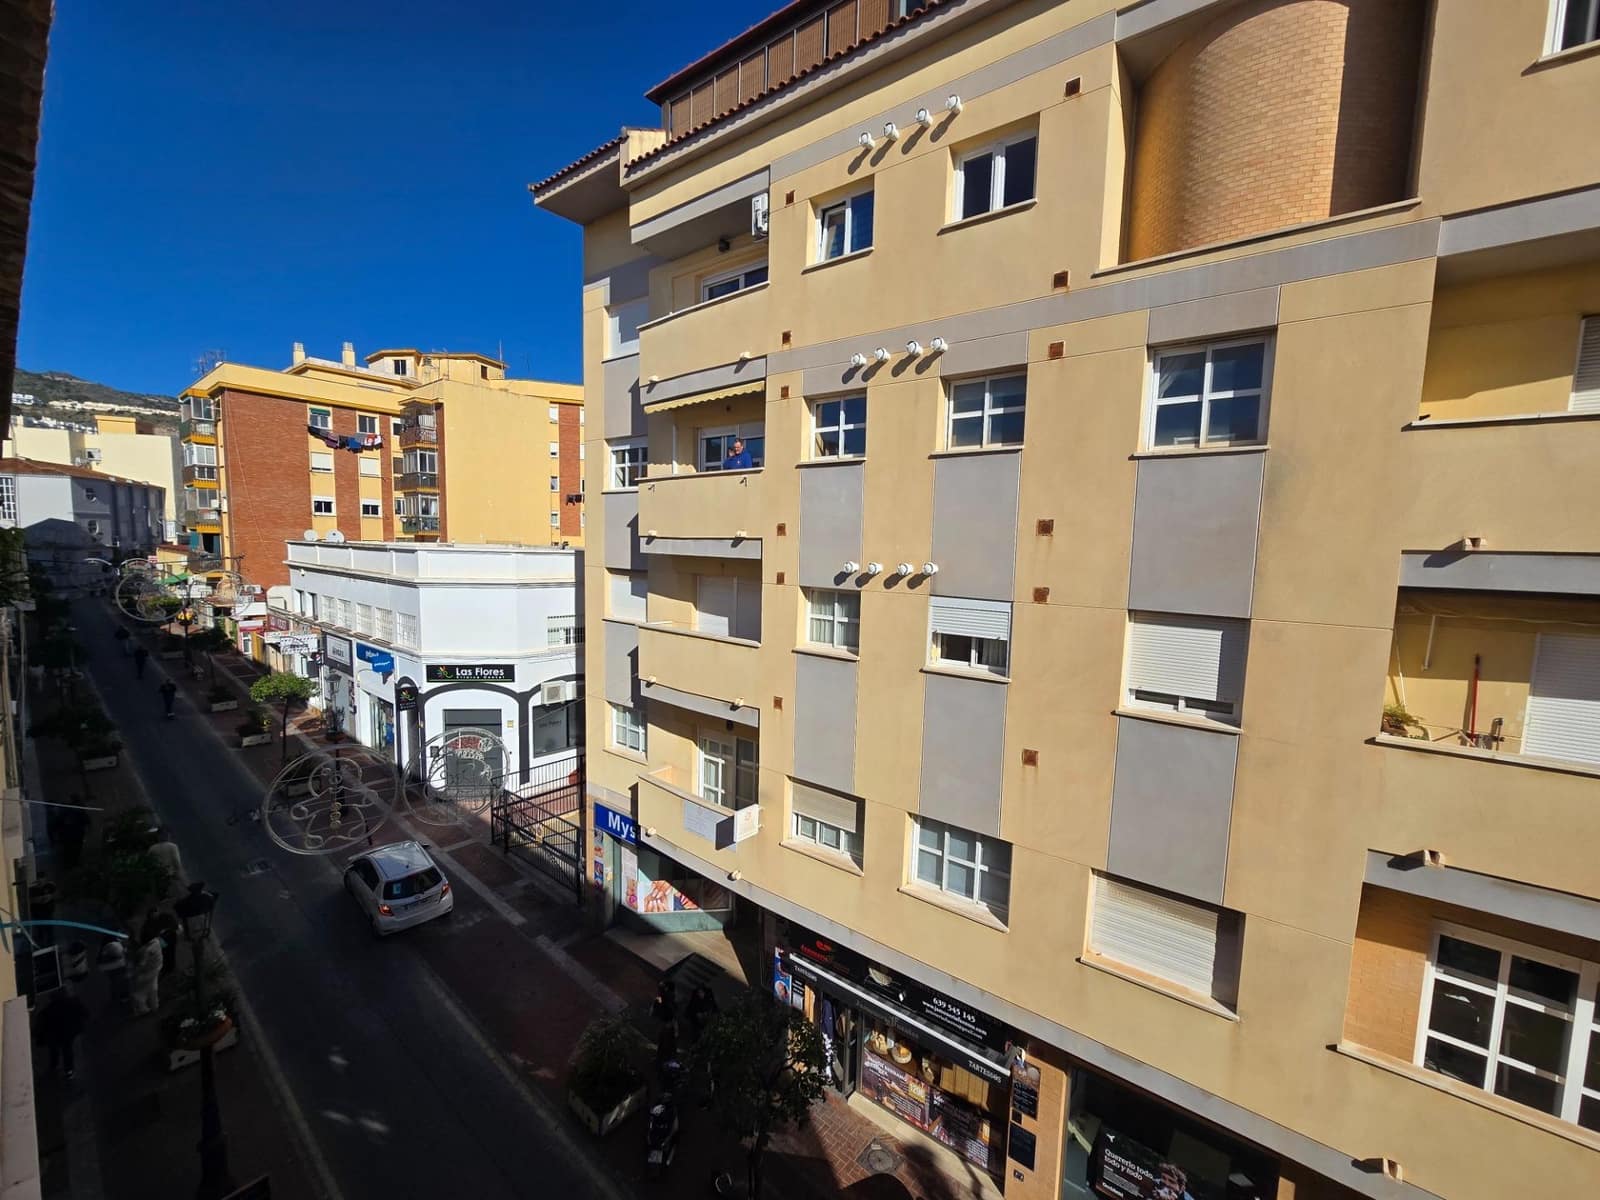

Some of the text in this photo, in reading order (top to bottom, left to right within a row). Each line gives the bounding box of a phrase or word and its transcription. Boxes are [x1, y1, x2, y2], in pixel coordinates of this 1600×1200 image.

[456, 666, 504, 676] Las Flores
[933, 997, 946, 1008] 639
[1104, 1149, 1136, 1170] Quererlo
[1104, 1155, 1121, 1169] todo
[1126, 1168, 1143, 1181] todo
